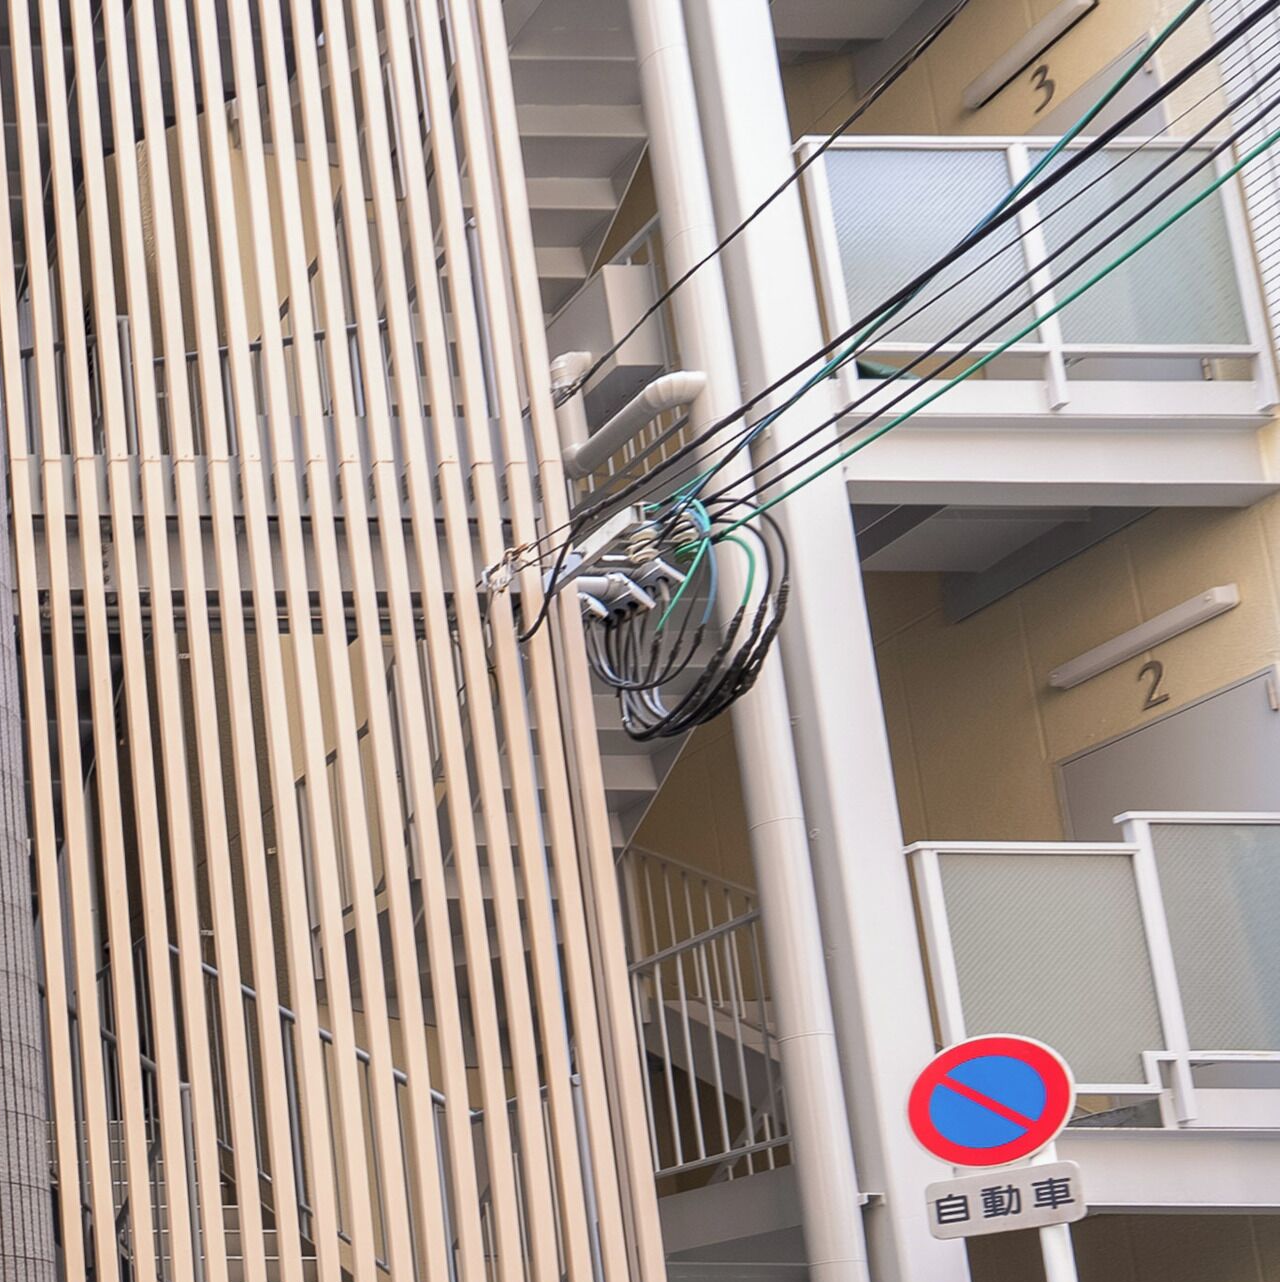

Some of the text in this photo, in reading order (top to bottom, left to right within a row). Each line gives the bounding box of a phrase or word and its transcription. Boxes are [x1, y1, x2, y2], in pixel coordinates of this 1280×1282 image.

[1029, 64, 1056, 115] 3
[1136, 660, 1170, 712] 2
[935, 1177, 1075, 1225] 自動車
